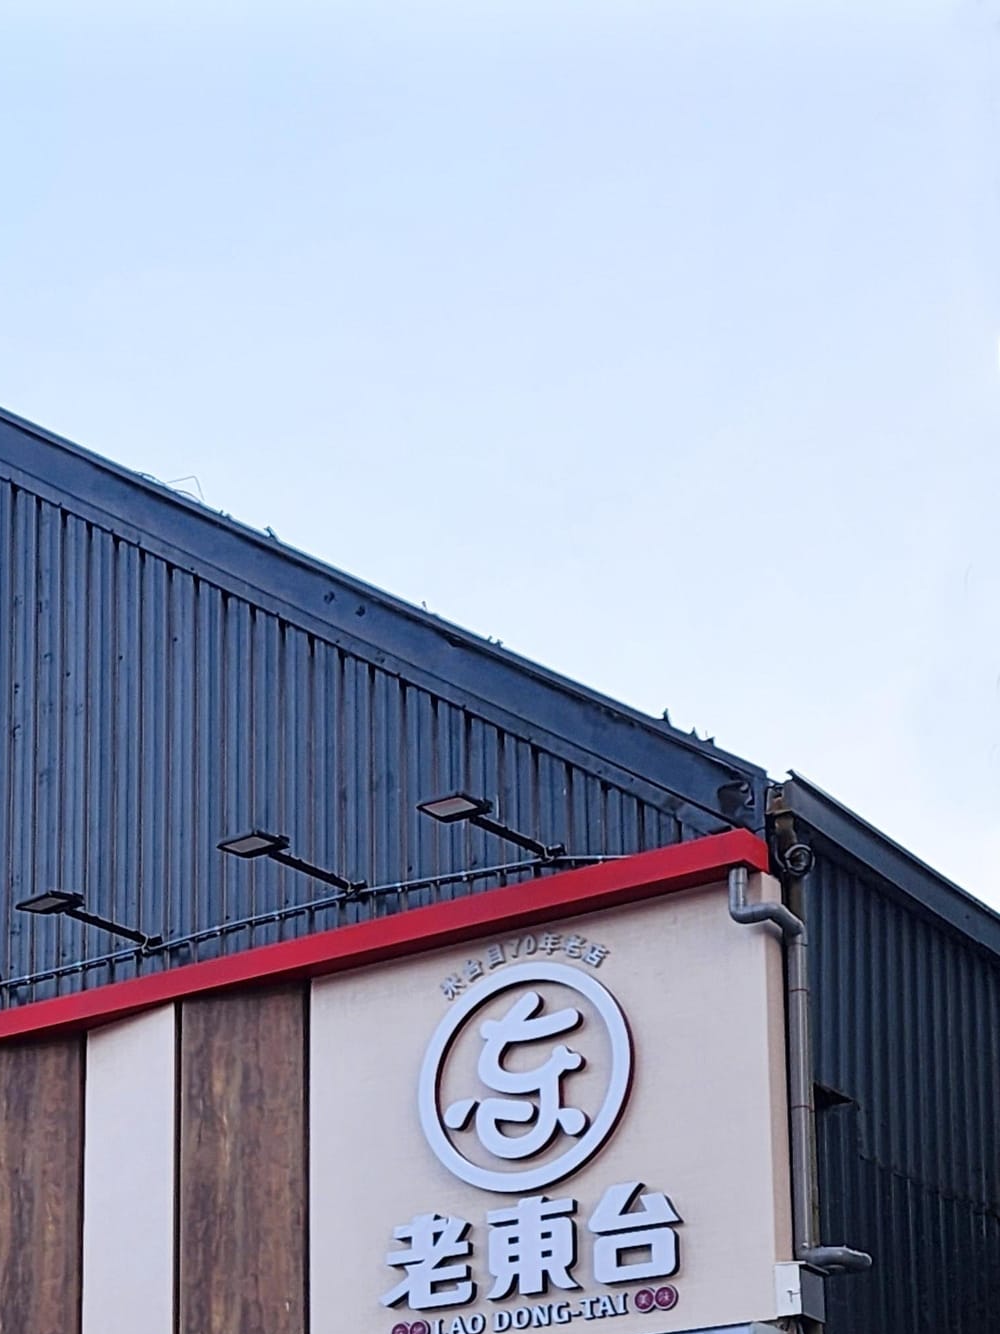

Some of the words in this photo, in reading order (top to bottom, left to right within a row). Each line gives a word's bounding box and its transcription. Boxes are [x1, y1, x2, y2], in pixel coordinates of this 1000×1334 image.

[380, 1181, 685, 1311] 老東台
[493, 1292, 629, 1333] DONG-TAI
